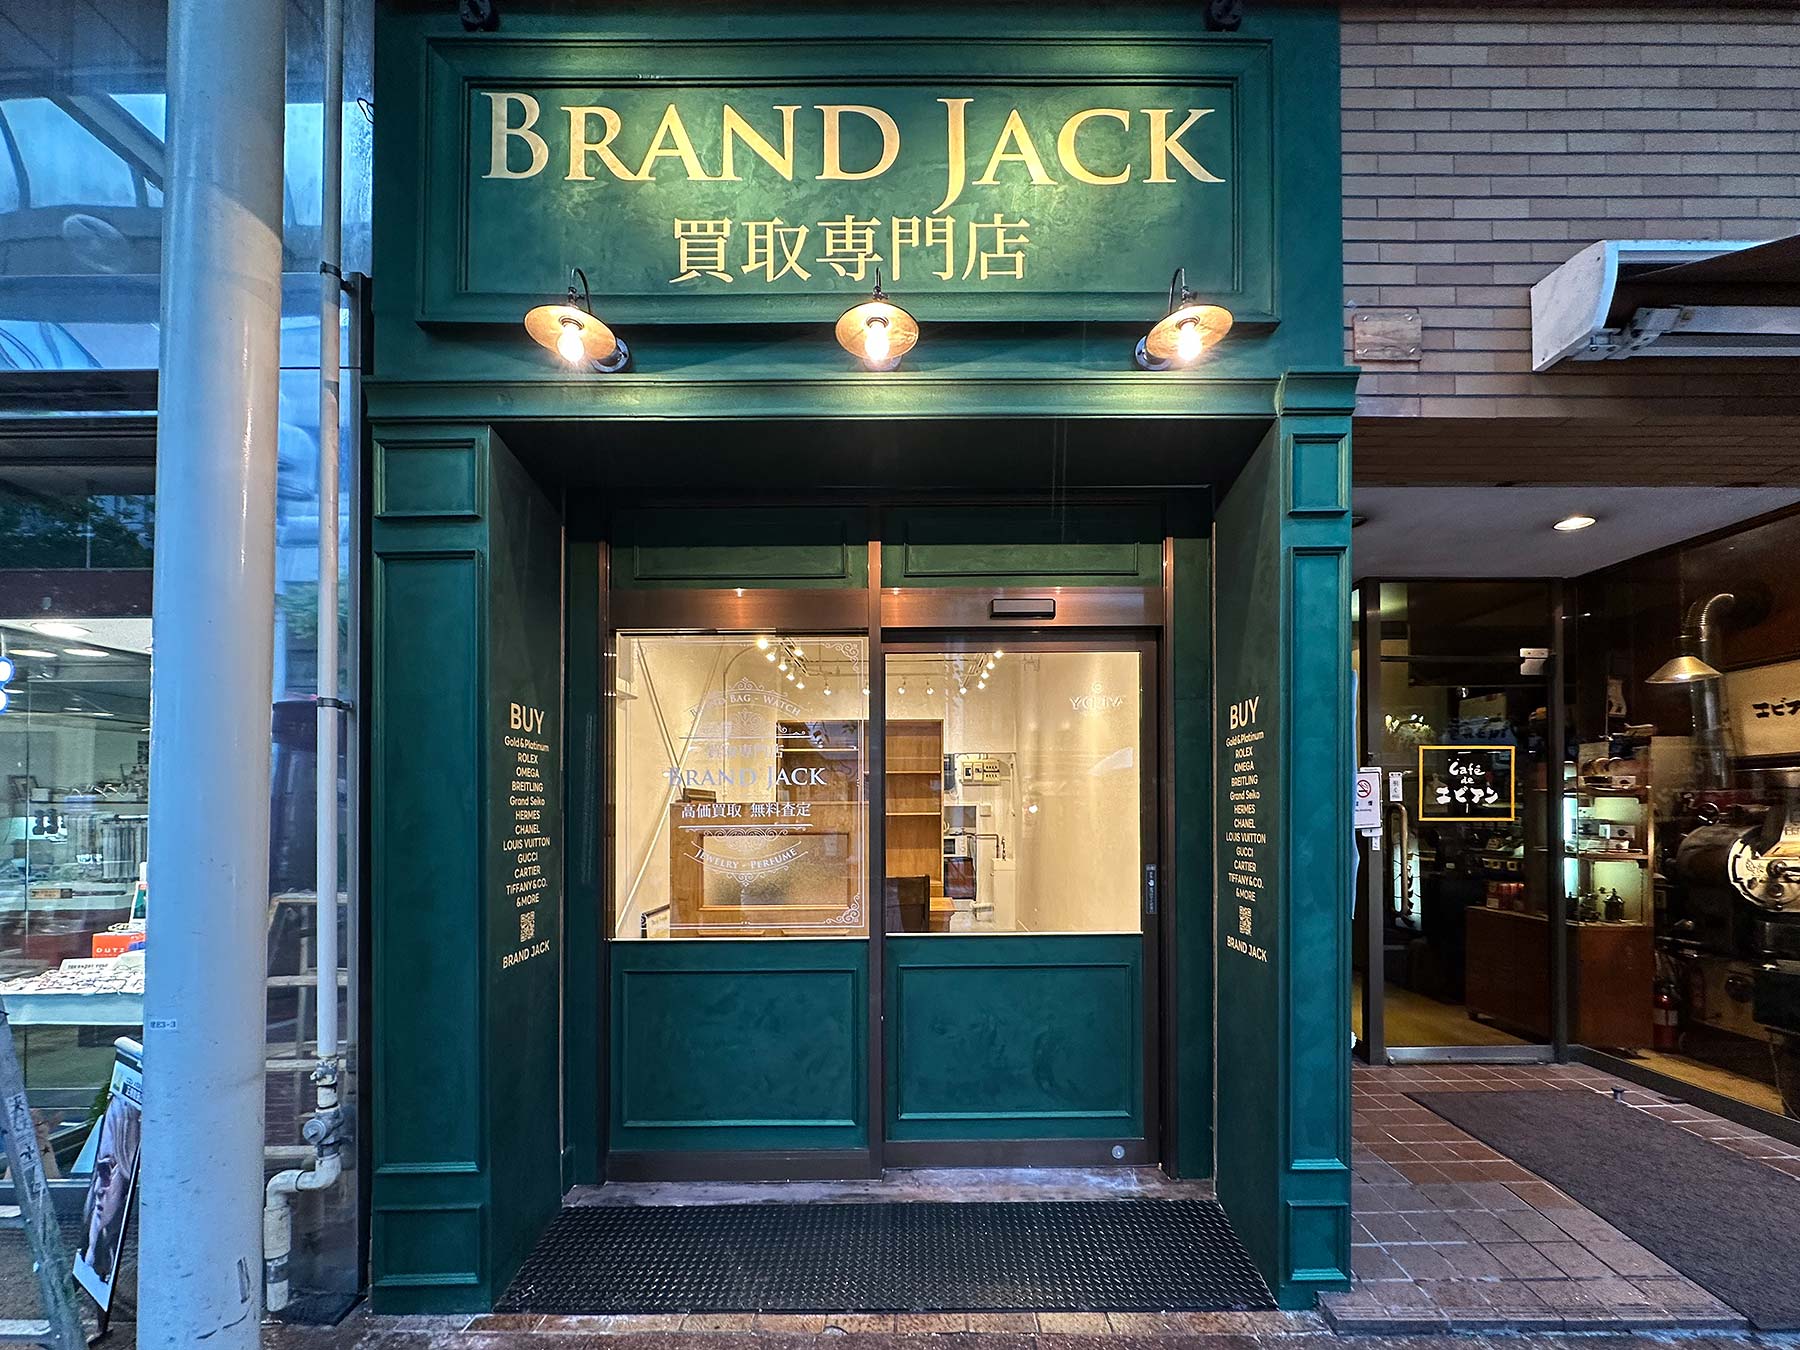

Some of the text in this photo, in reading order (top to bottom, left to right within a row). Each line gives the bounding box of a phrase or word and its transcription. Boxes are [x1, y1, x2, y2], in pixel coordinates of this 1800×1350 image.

[481, 91, 1227, 214] BRAND JACK
[668, 215, 1031, 285] 買取専門店
[730, 694, 751, 703] BAG
[763, 695, 801, 717] WATCH
[510, 703, 545, 734] BUY
[1230, 696, 1259, 730] BUY
[517, 752, 538, 764] ROLEX
[1235, 746, 1253, 758] ROLEX
[516, 766, 540, 778] OMEGA
[1234, 761, 1254, 773] OMEGA
[1448, 762, 1486, 776] Café
[669, 767, 827, 789] BRAND JACK
[1231, 775, 1258, 787] BREITLING
[1460, 776, 1474, 784] de
[511, 781, 544, 792] BREITLING
[509, 796, 545, 806] Grand Seiko
[1230, 789, 1260, 801] Grand Seiko
[1436, 786, 1498, 805] エビアン
[515, 810, 541, 820] HERMES
[681, 801, 811, 818] 高価買取 無料査定
[1234, 804, 1256, 814] HERMES
[515, 824, 540, 834] CHANEL
[1234, 818, 1256, 829] CHANEL
[503, 837, 551, 851] LOUIS VUITTON
[1225, 832, 1266, 844] LOUIS VUITTON
[517, 852, 538, 863] GUCCI
[1236, 847, 1254, 857] GUCCI
[695, 848, 739, 869] JEWELRY
[750, 848, 798, 869] PERFUME
[514, 865, 541, 878] CARTIER
[1234, 860, 1257, 872] CARTIER
[1235, 887, 1256, 901] &MORE
[516, 893, 540, 908] &MORE
[502, 939, 551, 969] BRAND JACK
[1226, 935, 1268, 963] BRAND JACK
